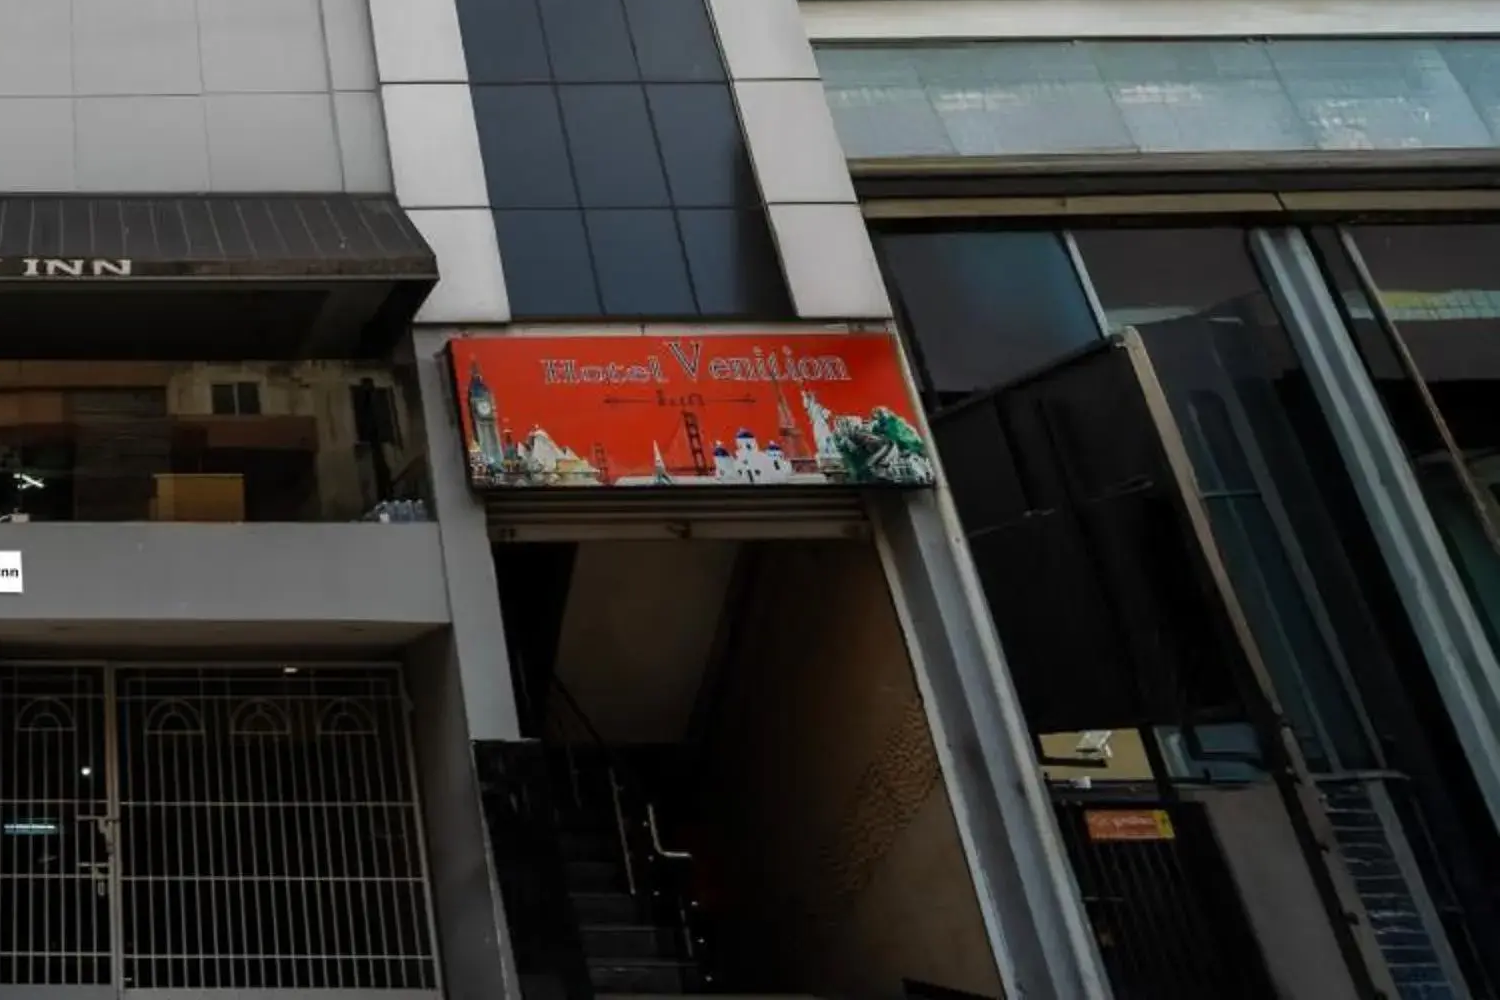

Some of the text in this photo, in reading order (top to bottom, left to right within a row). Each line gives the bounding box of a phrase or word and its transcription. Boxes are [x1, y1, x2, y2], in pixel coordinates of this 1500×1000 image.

[22, 257, 132, 277] INN
[540, 339, 852, 386] Hotel Venition
